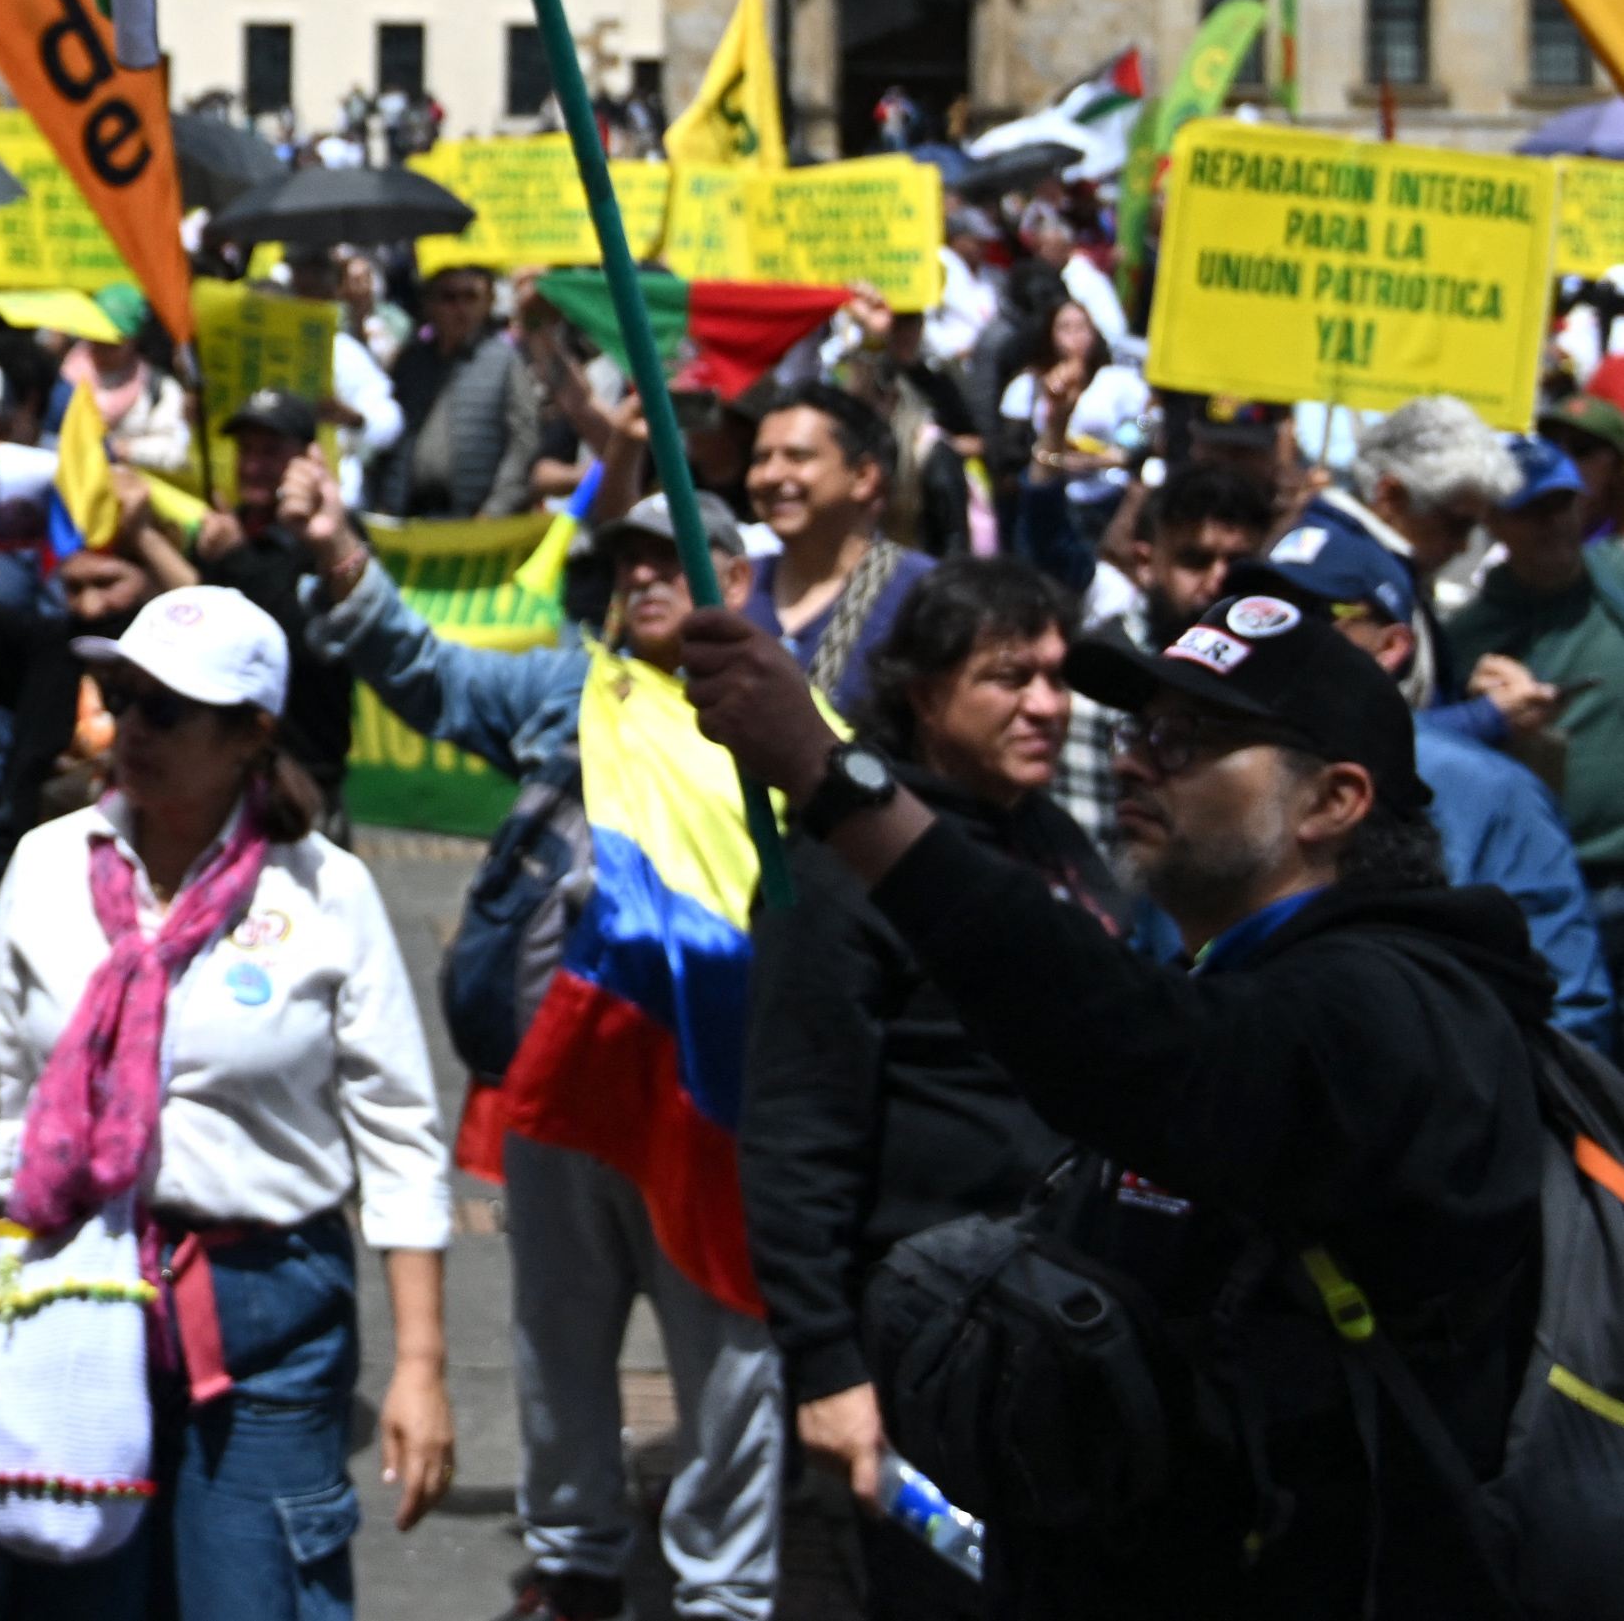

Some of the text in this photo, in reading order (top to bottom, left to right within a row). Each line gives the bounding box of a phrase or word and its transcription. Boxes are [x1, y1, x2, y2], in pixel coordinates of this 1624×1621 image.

[1389, 170, 1533, 223] INTEGRAL
[1284, 209, 1425, 260] PARA LA
